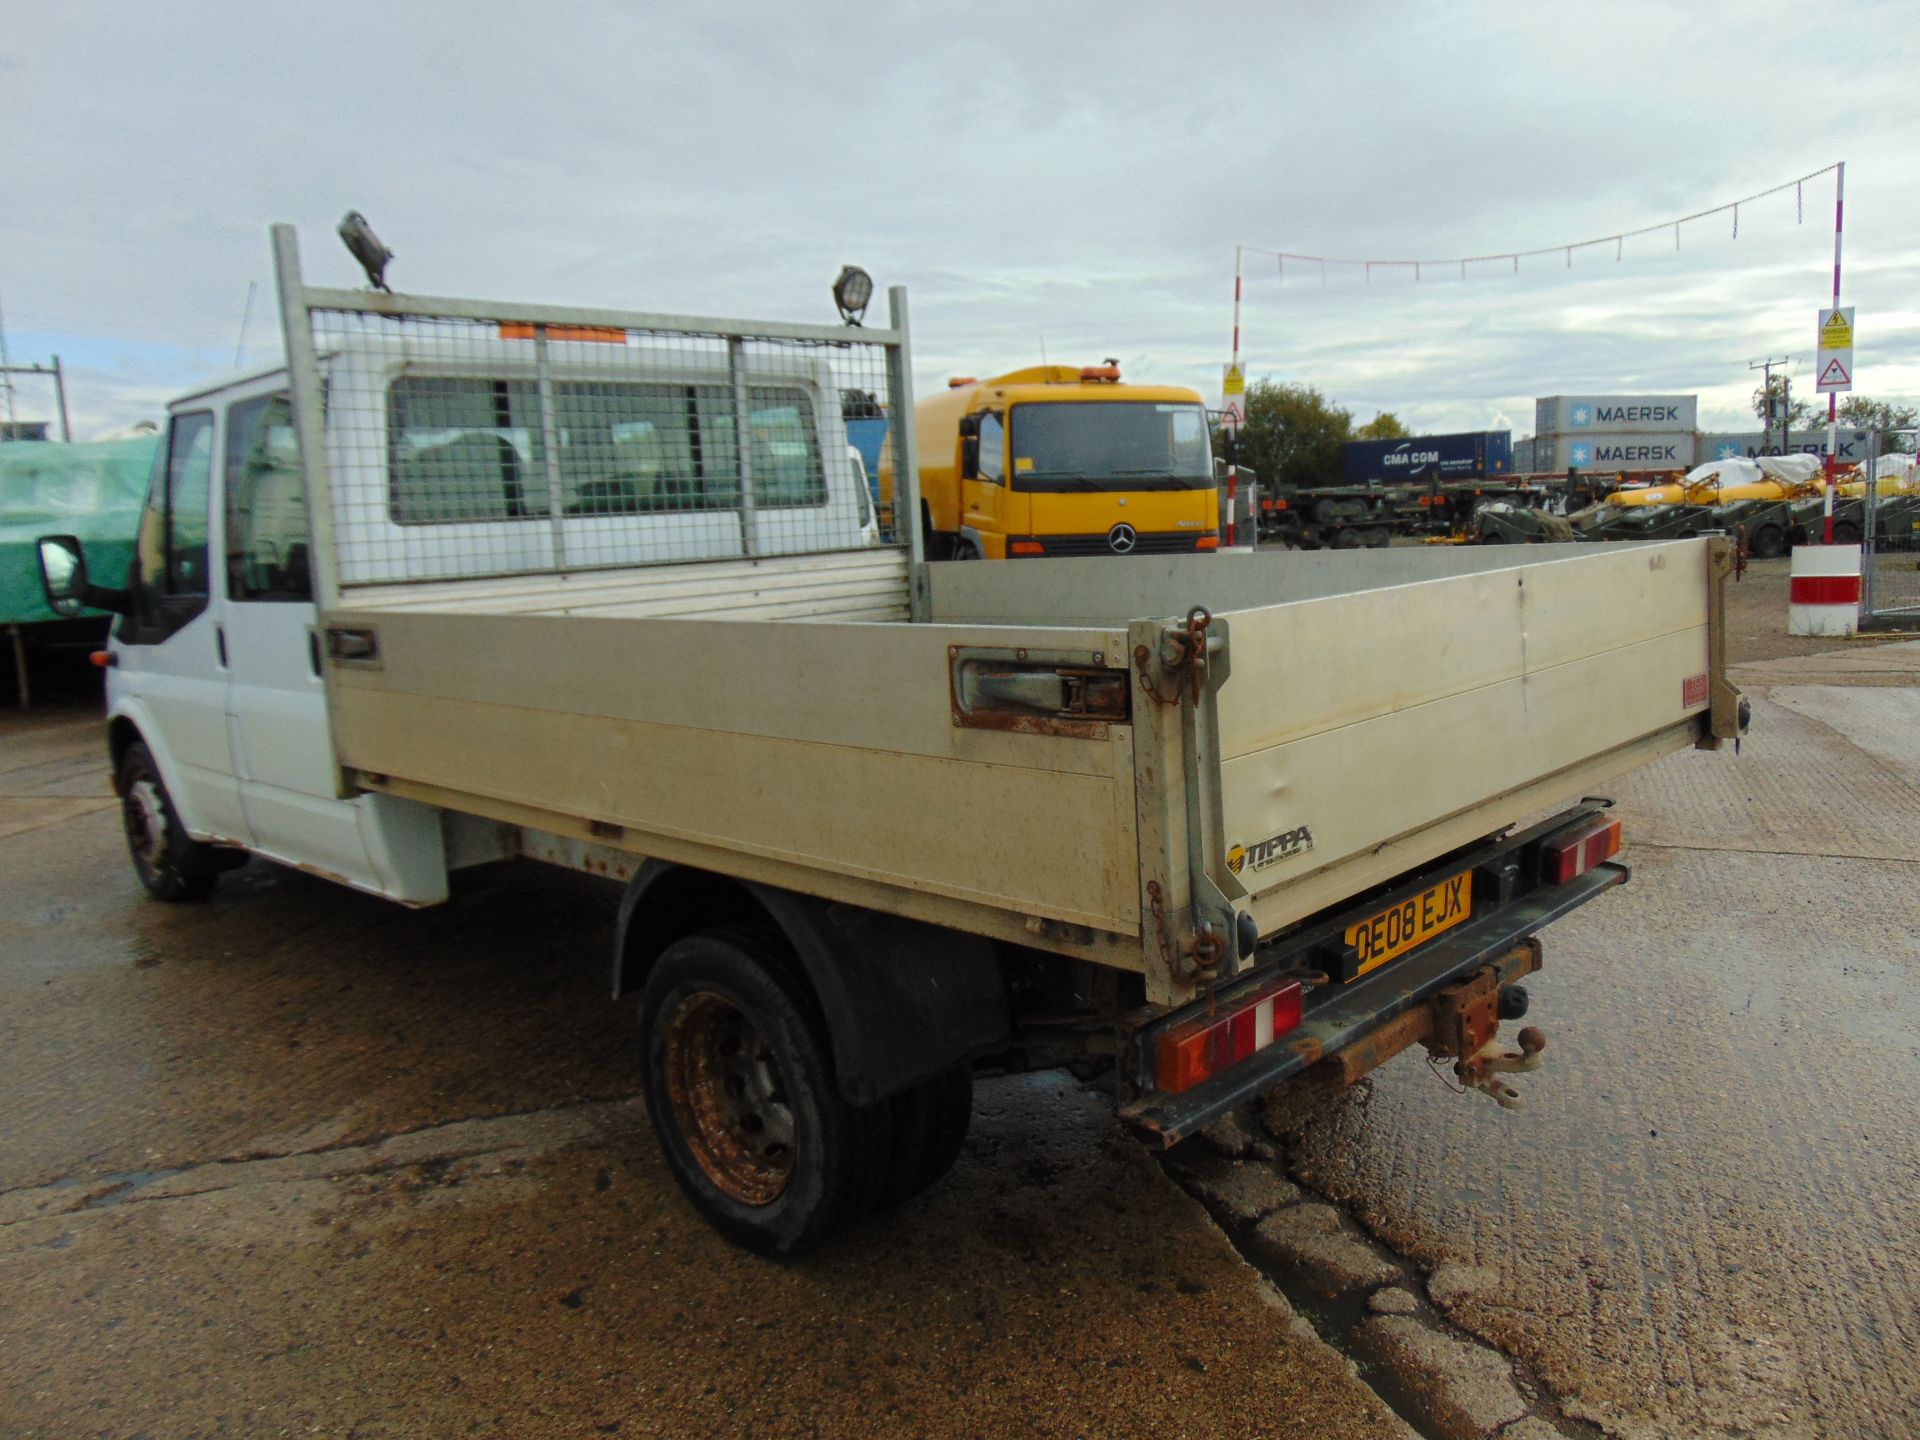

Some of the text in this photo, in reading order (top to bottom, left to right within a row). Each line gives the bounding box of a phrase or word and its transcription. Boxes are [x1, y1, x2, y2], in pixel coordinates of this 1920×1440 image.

[1597, 406, 1679, 421] MAERSK
[1383, 453, 1409, 466] CMA
[1411, 451, 1439, 464] CGM
[1596, 446, 1676, 461] MAERSK
[1245, 826, 1313, 865] TIPPA
[1421, 876, 1462, 932] EJX
